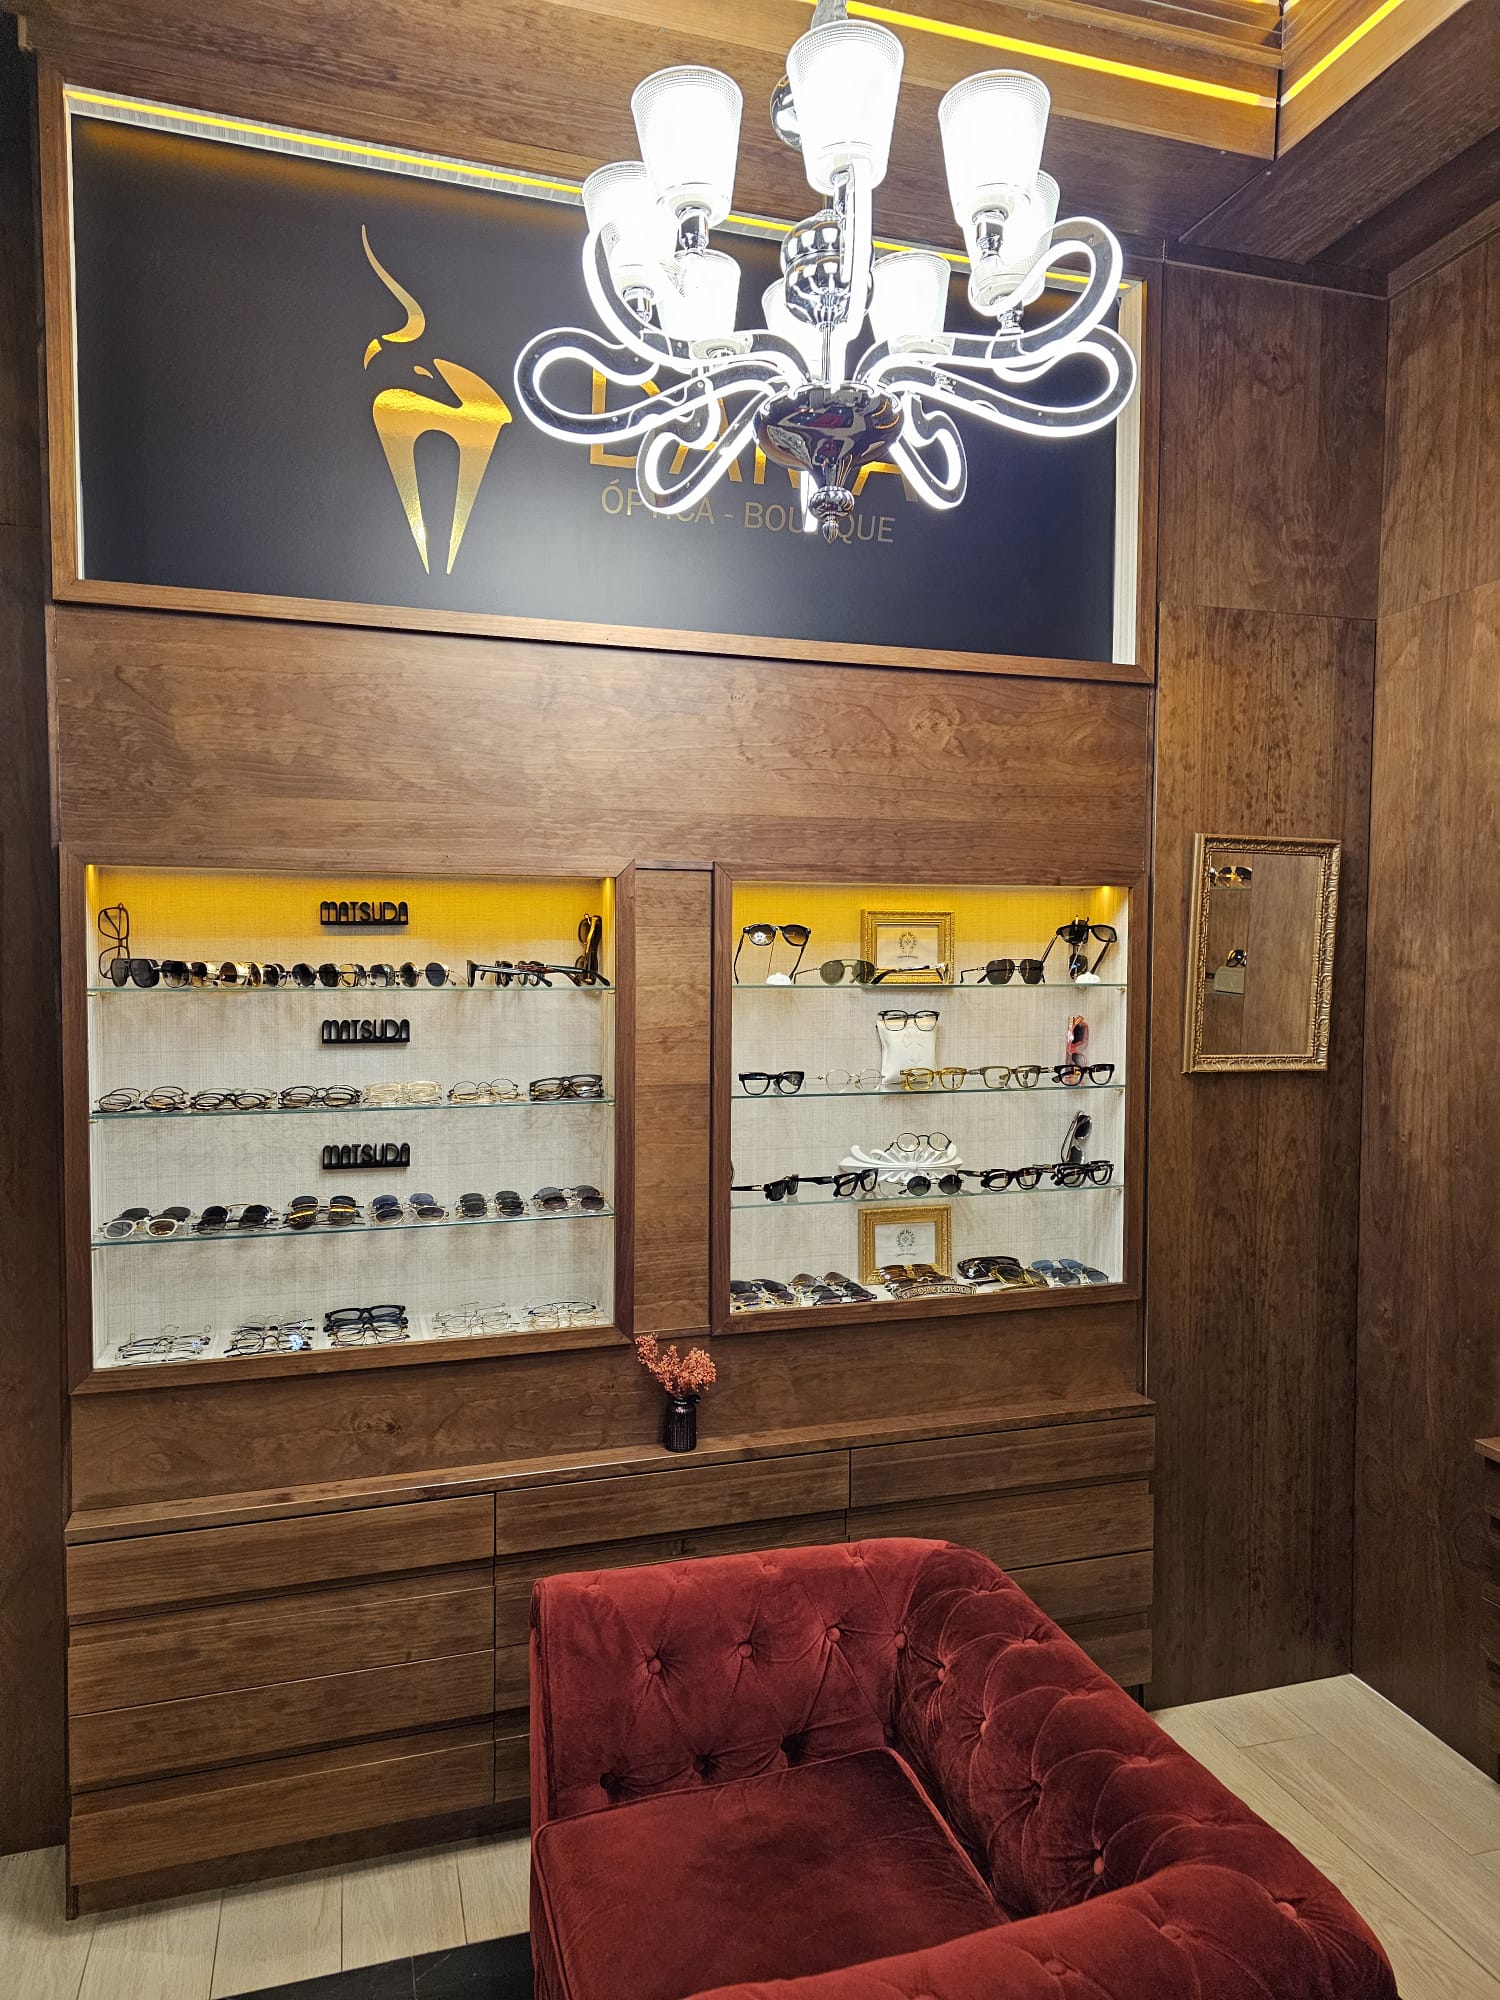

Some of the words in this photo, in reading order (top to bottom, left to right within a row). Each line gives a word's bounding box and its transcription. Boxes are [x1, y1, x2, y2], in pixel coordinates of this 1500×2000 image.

[601, 478, 715, 525] ÓPA
[744, 501, 896, 545] BOUQUE
[320, 901, 408, 925] MATSUDA
[322, 1019, 410, 1042] MATSUDA
[323, 1142, 410, 1169] MATSUDA
